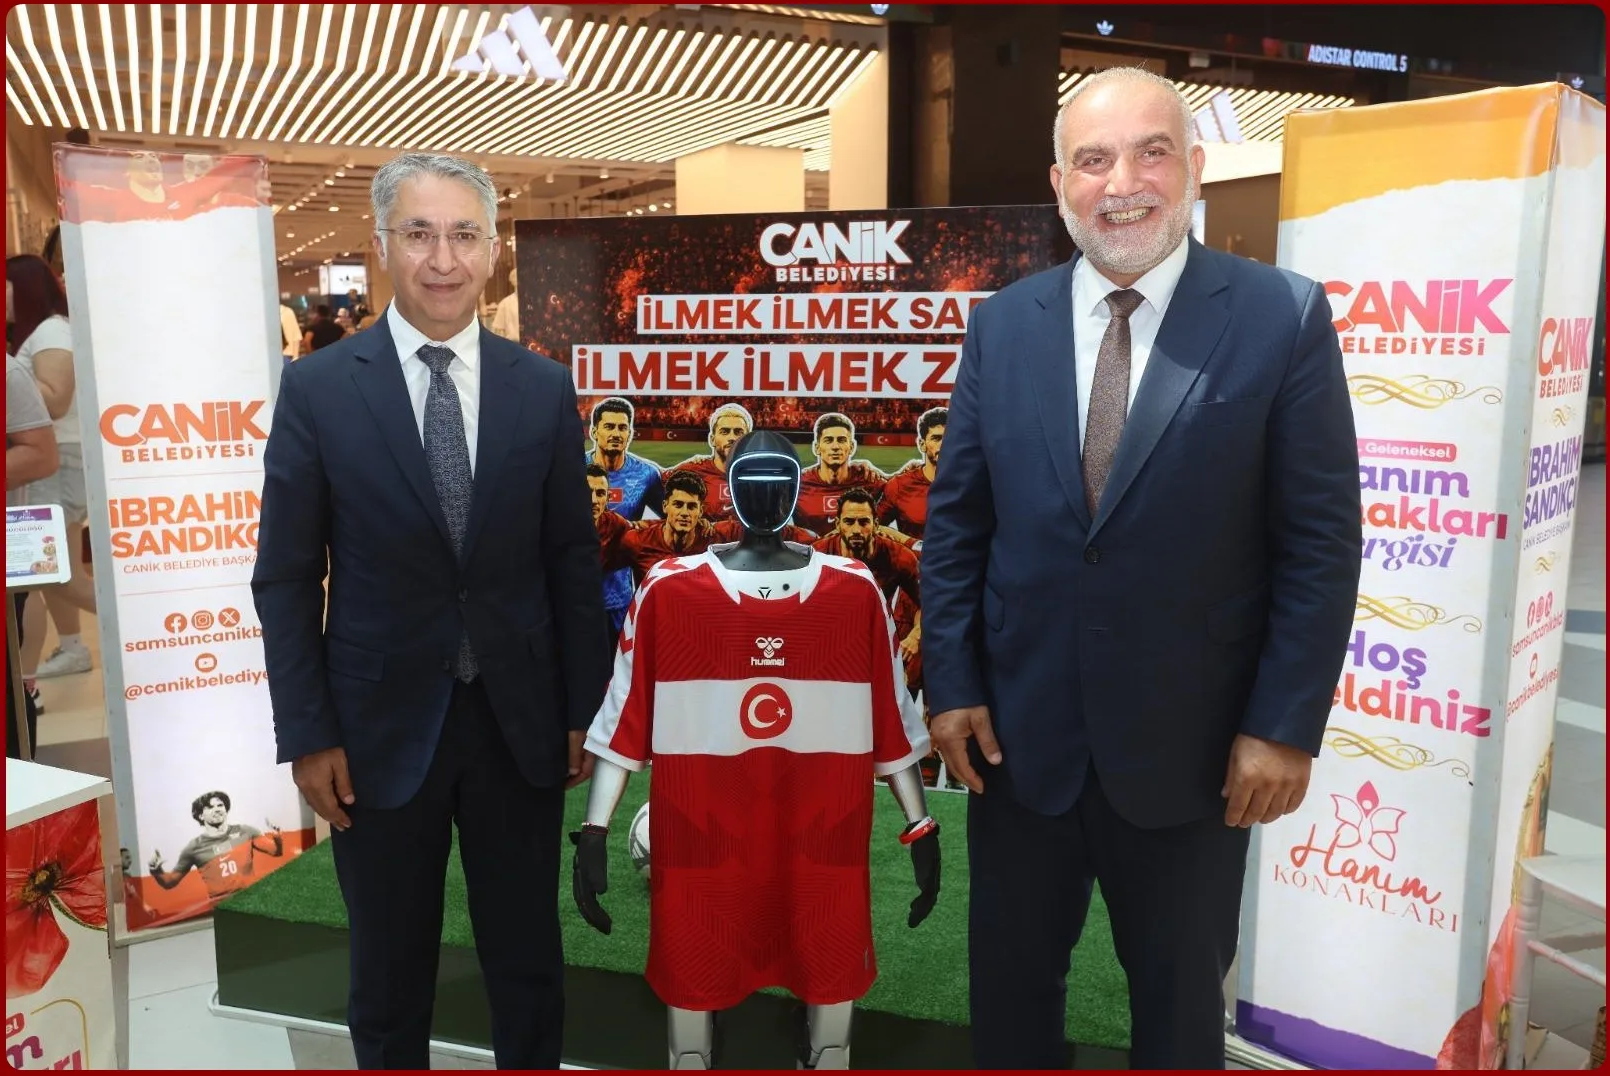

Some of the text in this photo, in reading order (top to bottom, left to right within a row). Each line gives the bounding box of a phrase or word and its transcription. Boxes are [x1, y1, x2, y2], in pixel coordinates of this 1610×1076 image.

[1308, 44, 1408, 72] ADISTAR CONTROL 5
[1342, 337, 1485, 356] ELEDİYESİ
[1365, 442, 1451, 459] Geleneksel
[1359, 464, 1470, 498] anım
[1362, 496, 1508, 540] akları
[124, 561, 160, 574] CANİK
[164, 556, 219, 572] BELEDİYE
[1362, 534, 1457, 571] rgisi
[125, 626, 263, 652] samsuncanikb
[751, 656, 785, 667] hummel
[125, 669, 268, 700] @canikbelediye
[1332, 673, 1491, 737] ldiniz
[219, 860, 238, 877] 20
[1290, 822, 1442, 906] Hanım
[1273, 864, 1458, 934] KONAKLARI
